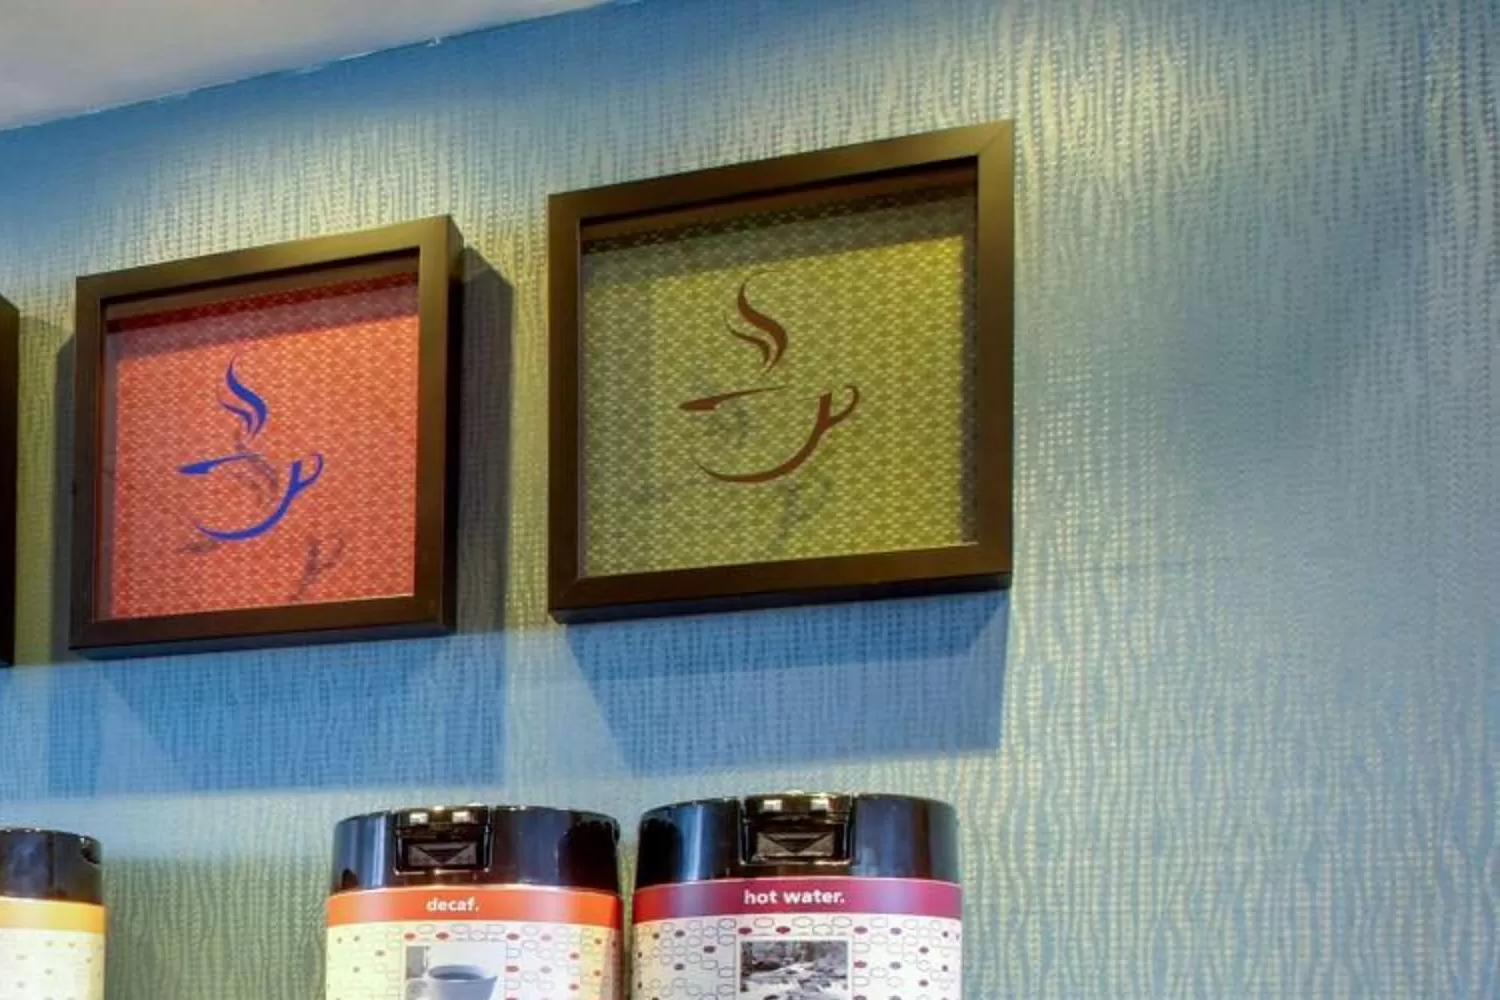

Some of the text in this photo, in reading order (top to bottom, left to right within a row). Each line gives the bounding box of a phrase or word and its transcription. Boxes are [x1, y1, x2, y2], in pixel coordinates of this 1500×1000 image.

[425, 896, 480, 912] decaf.
[743, 889, 845, 905] hot water.
